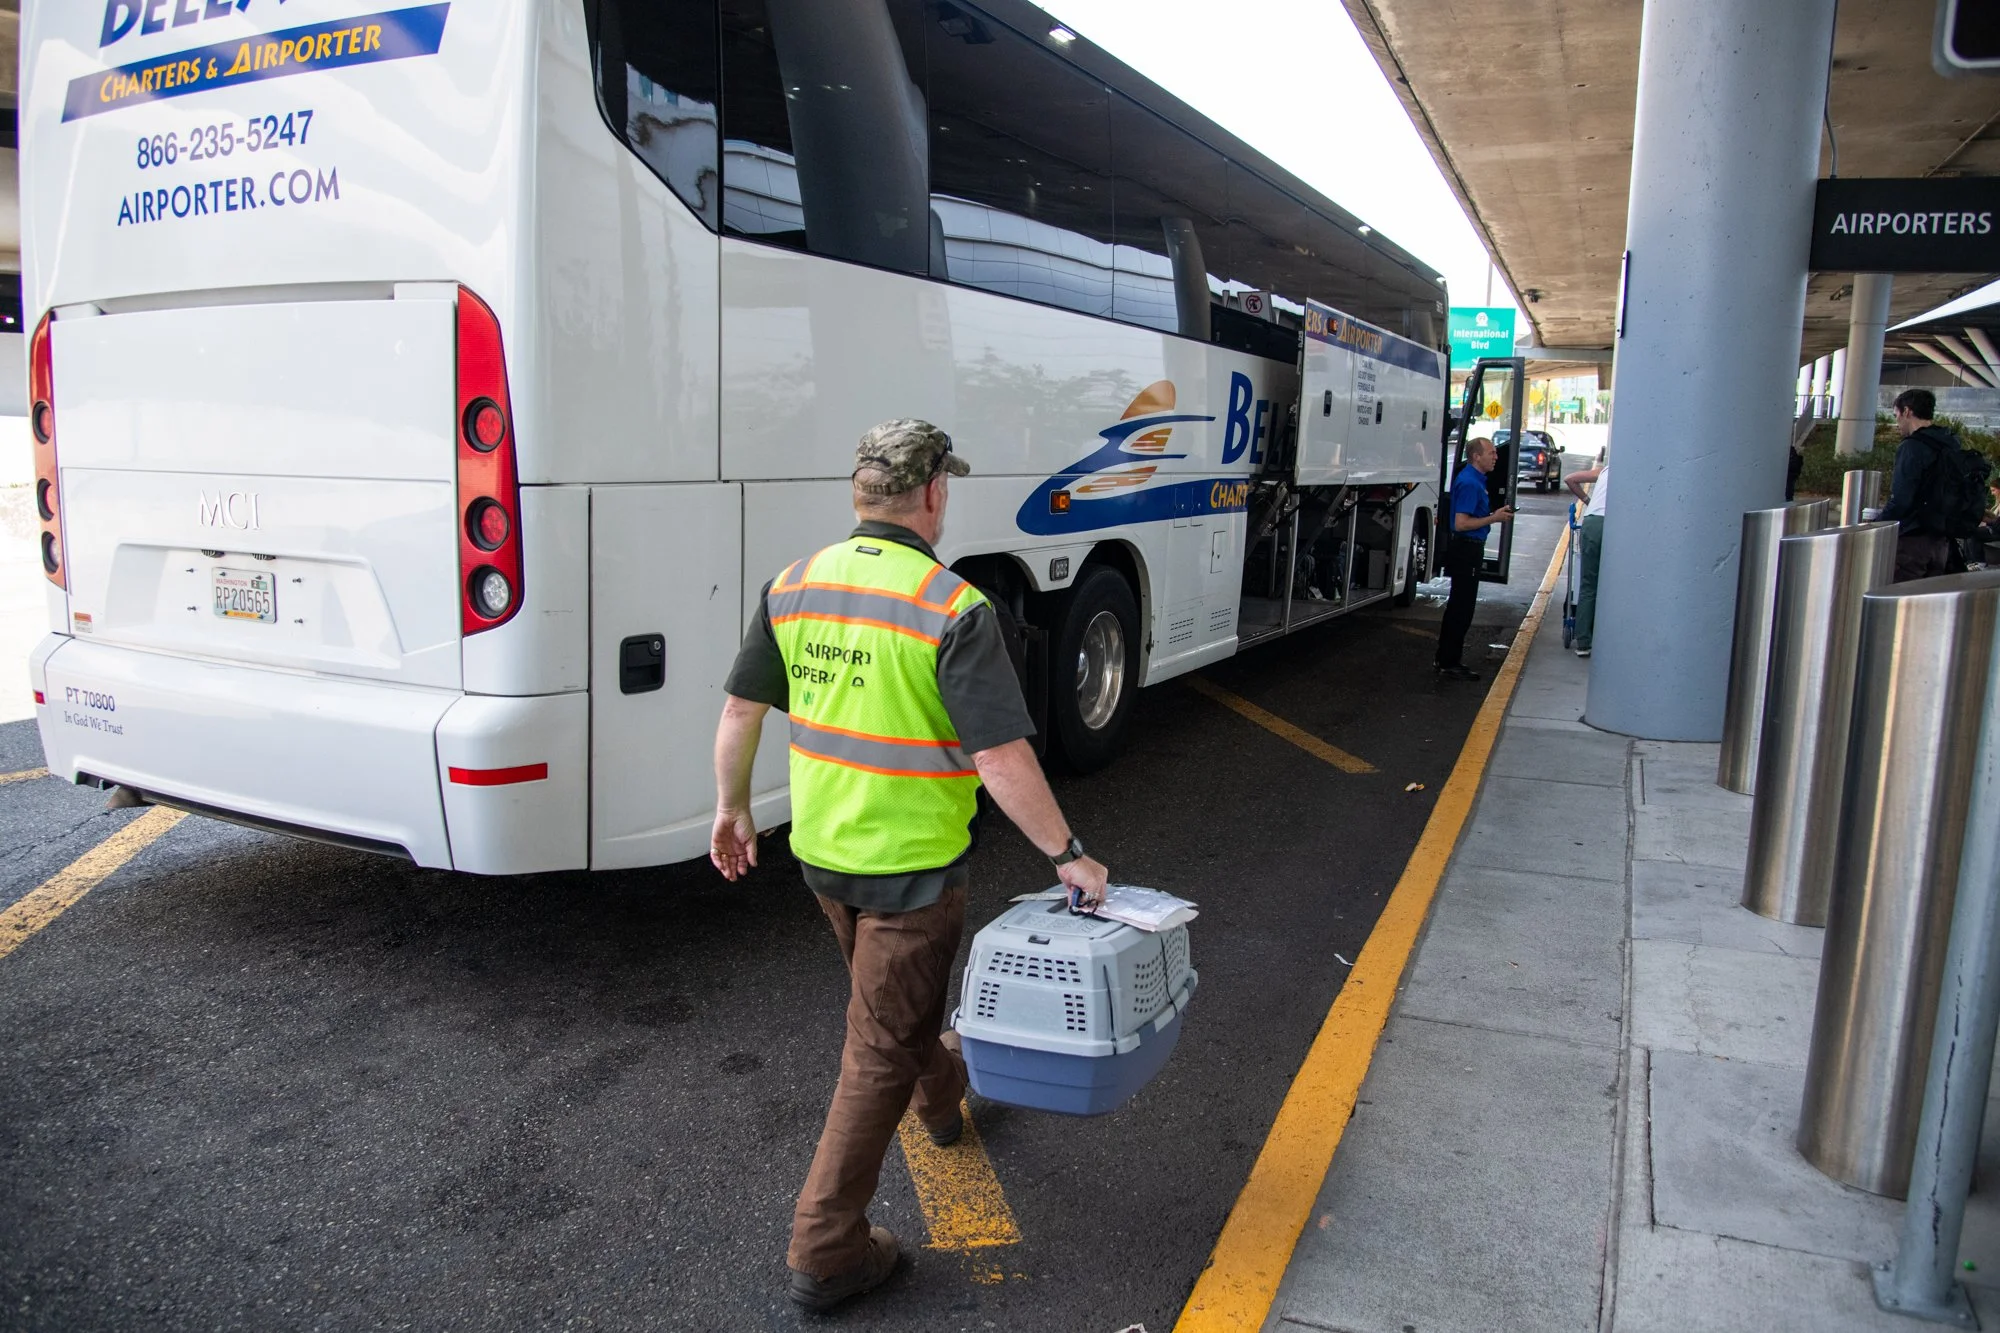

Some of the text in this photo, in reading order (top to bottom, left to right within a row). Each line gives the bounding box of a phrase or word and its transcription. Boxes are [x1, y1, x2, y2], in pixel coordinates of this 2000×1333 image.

[100, 25, 382, 103] CHARTERS & AIRPORTER
[137, 109, 314, 169] 866-235-5247
[117, 166, 340, 226] AIRPORTER.COM
[1830, 212, 1992, 234] AIRPORTERS
[1453, 329, 1509, 339] International
[1471, 341, 1490, 350] Blvd
[199, 488, 262, 531] MCI
[215, 586, 270, 614] RP20565
[65, 686, 115, 711] PT 70800
[73, 713, 88, 727] God
[89, 716, 101, 731] We
[102, 719, 123, 735] Trust
